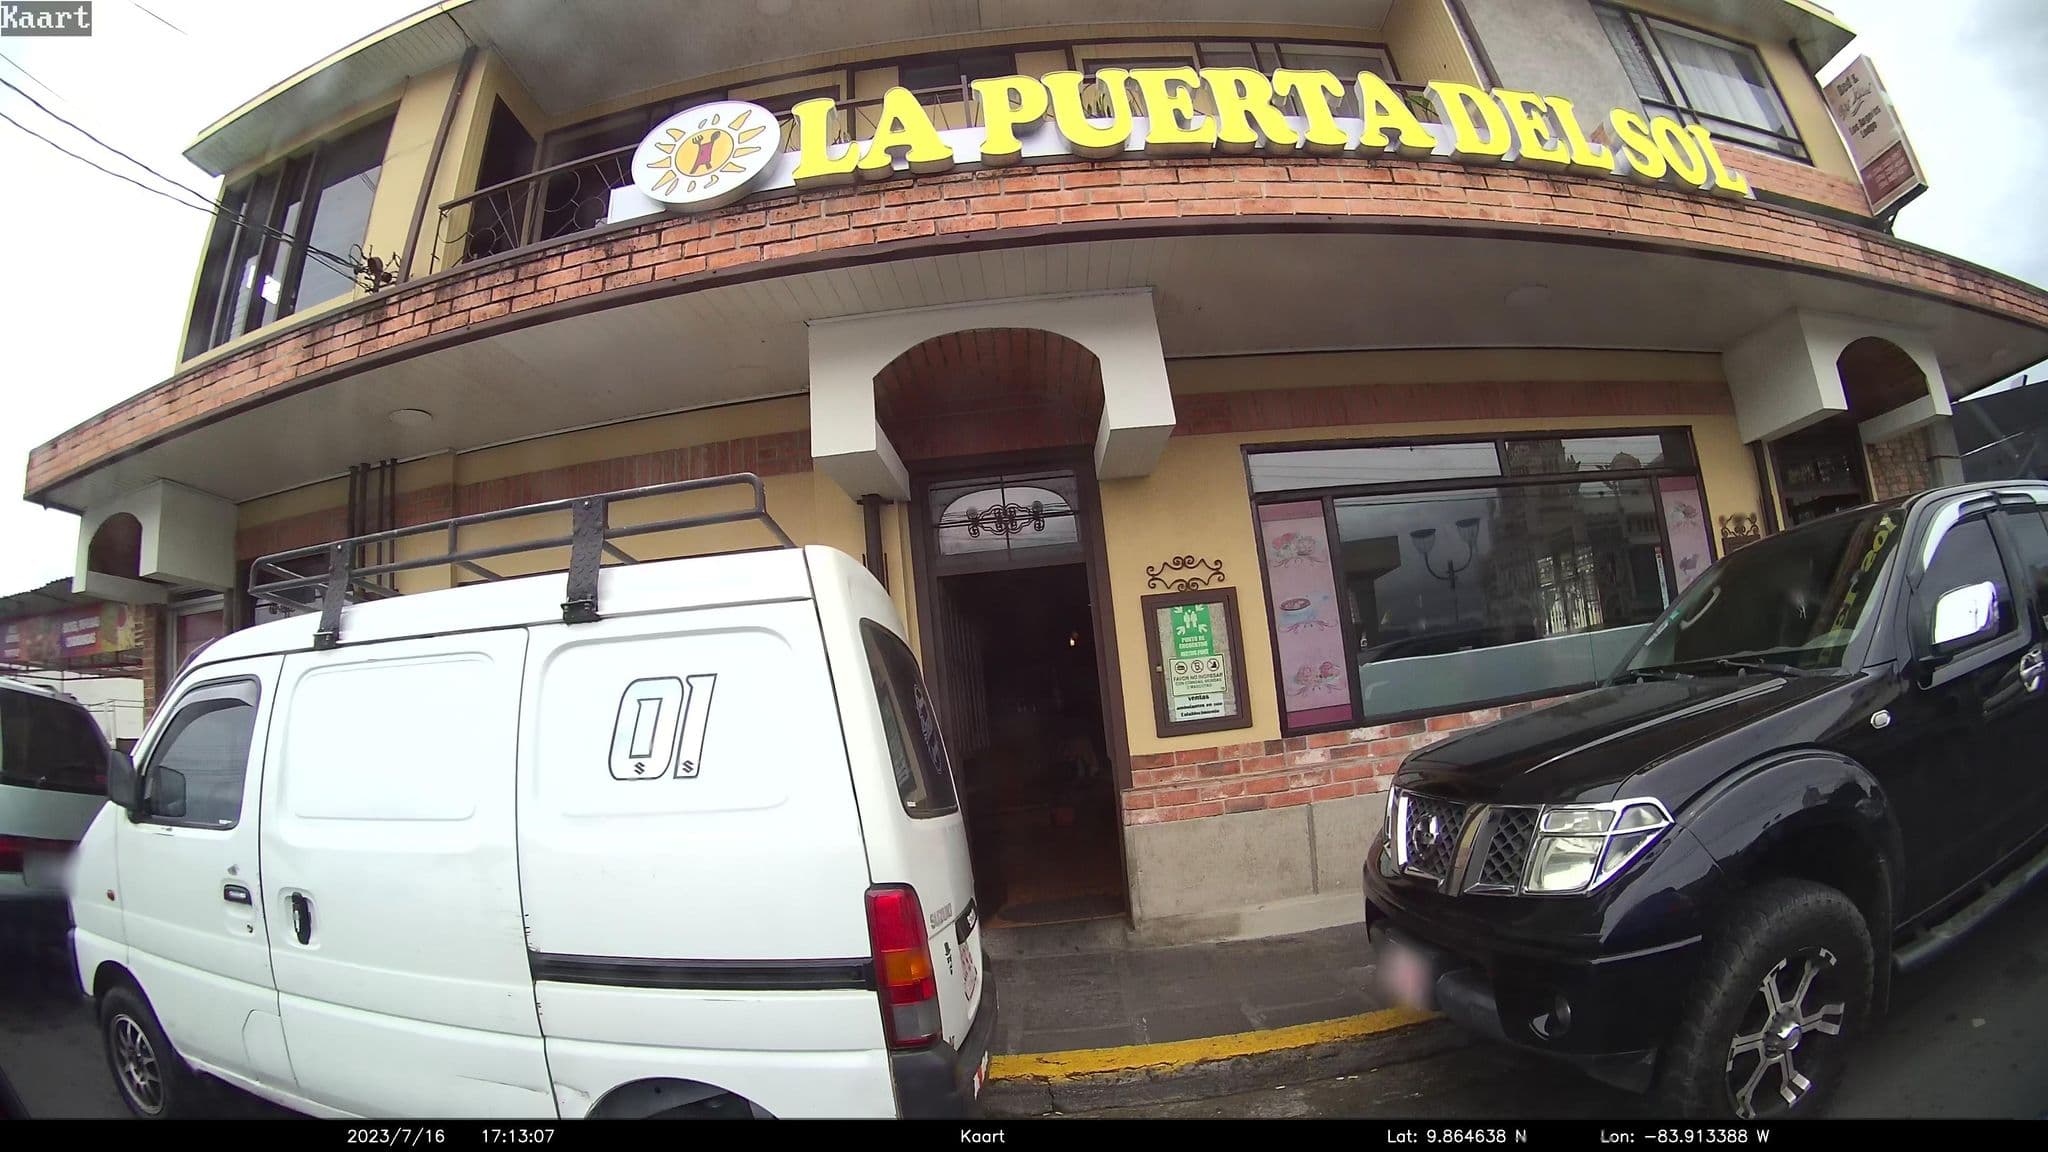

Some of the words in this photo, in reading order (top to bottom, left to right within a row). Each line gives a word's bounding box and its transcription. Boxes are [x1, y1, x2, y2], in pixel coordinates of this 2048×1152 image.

[794, 86, 953, 181] LA
[971, 67, 1437, 160] PUERTA
[1429, 79, 1614, 173] DEL
[1612, 108, 1748, 198] SOL
